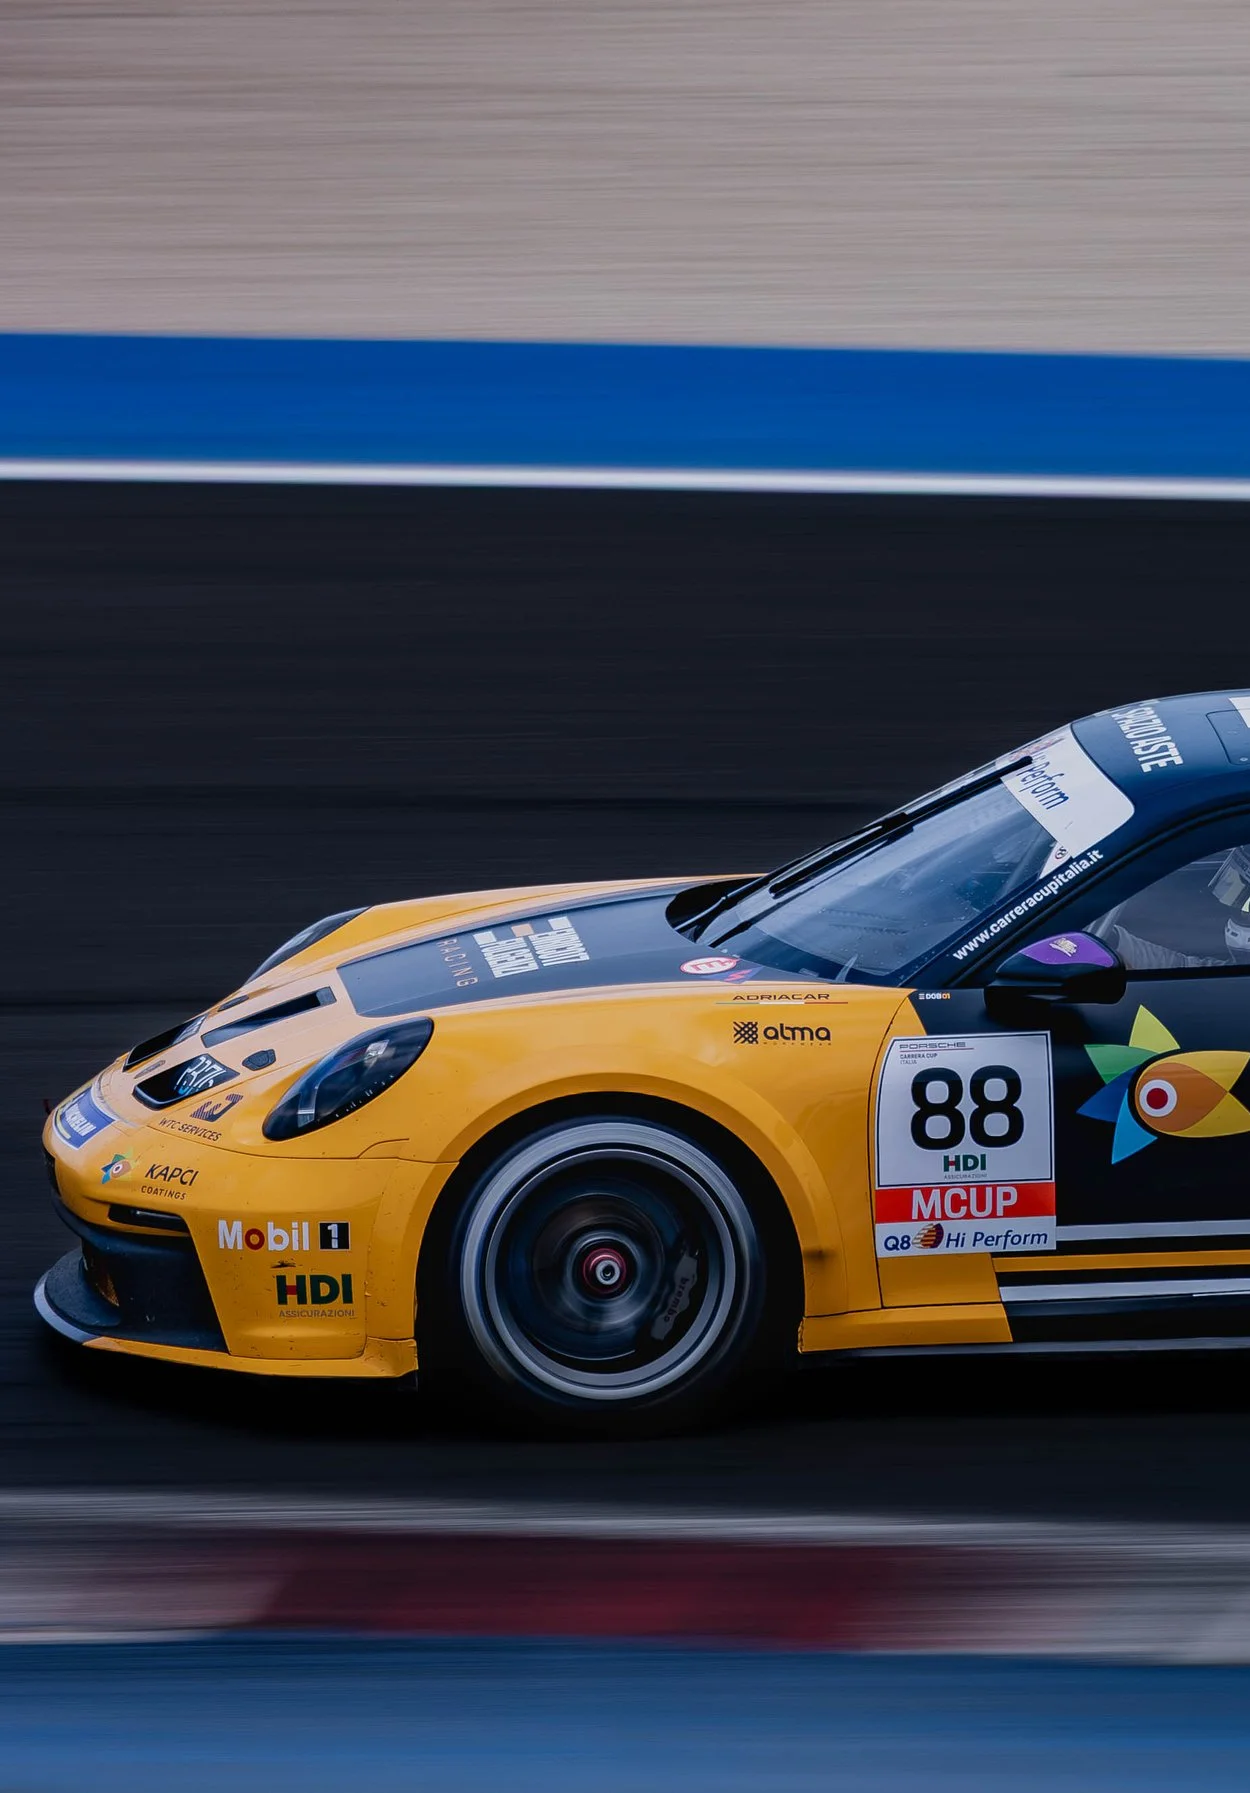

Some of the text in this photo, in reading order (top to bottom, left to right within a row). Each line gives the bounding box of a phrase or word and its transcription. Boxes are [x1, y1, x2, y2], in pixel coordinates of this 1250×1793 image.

[1130, 735, 1184, 773] ASTE
[952, 849, 1105, 961] www.carreracupitalia.it
[436, 938, 479, 987] RACING
[733, 993, 831, 1001] ADRIACAR
[763, 1023, 832, 1041] alma
[900, 1042, 966, 1050] PORSCHE
[911, 1065, 1024, 1150] 88
[178, 1122, 222, 1142] SERVICES
[943, 1154, 987, 1172] HDI
[145, 1164, 199, 1187] KAPCI
[141, 1185, 187, 1201] COATINGS
[911, 1186, 1018, 1220] MCUP
[218, 1219, 340, 1251] Mobil 1
[884, 1231, 1048, 1251] Q8 Hi Perform
[276, 1274, 353, 1305] HDI
[279, 1309, 356, 1319] ASSICURAZIONI
